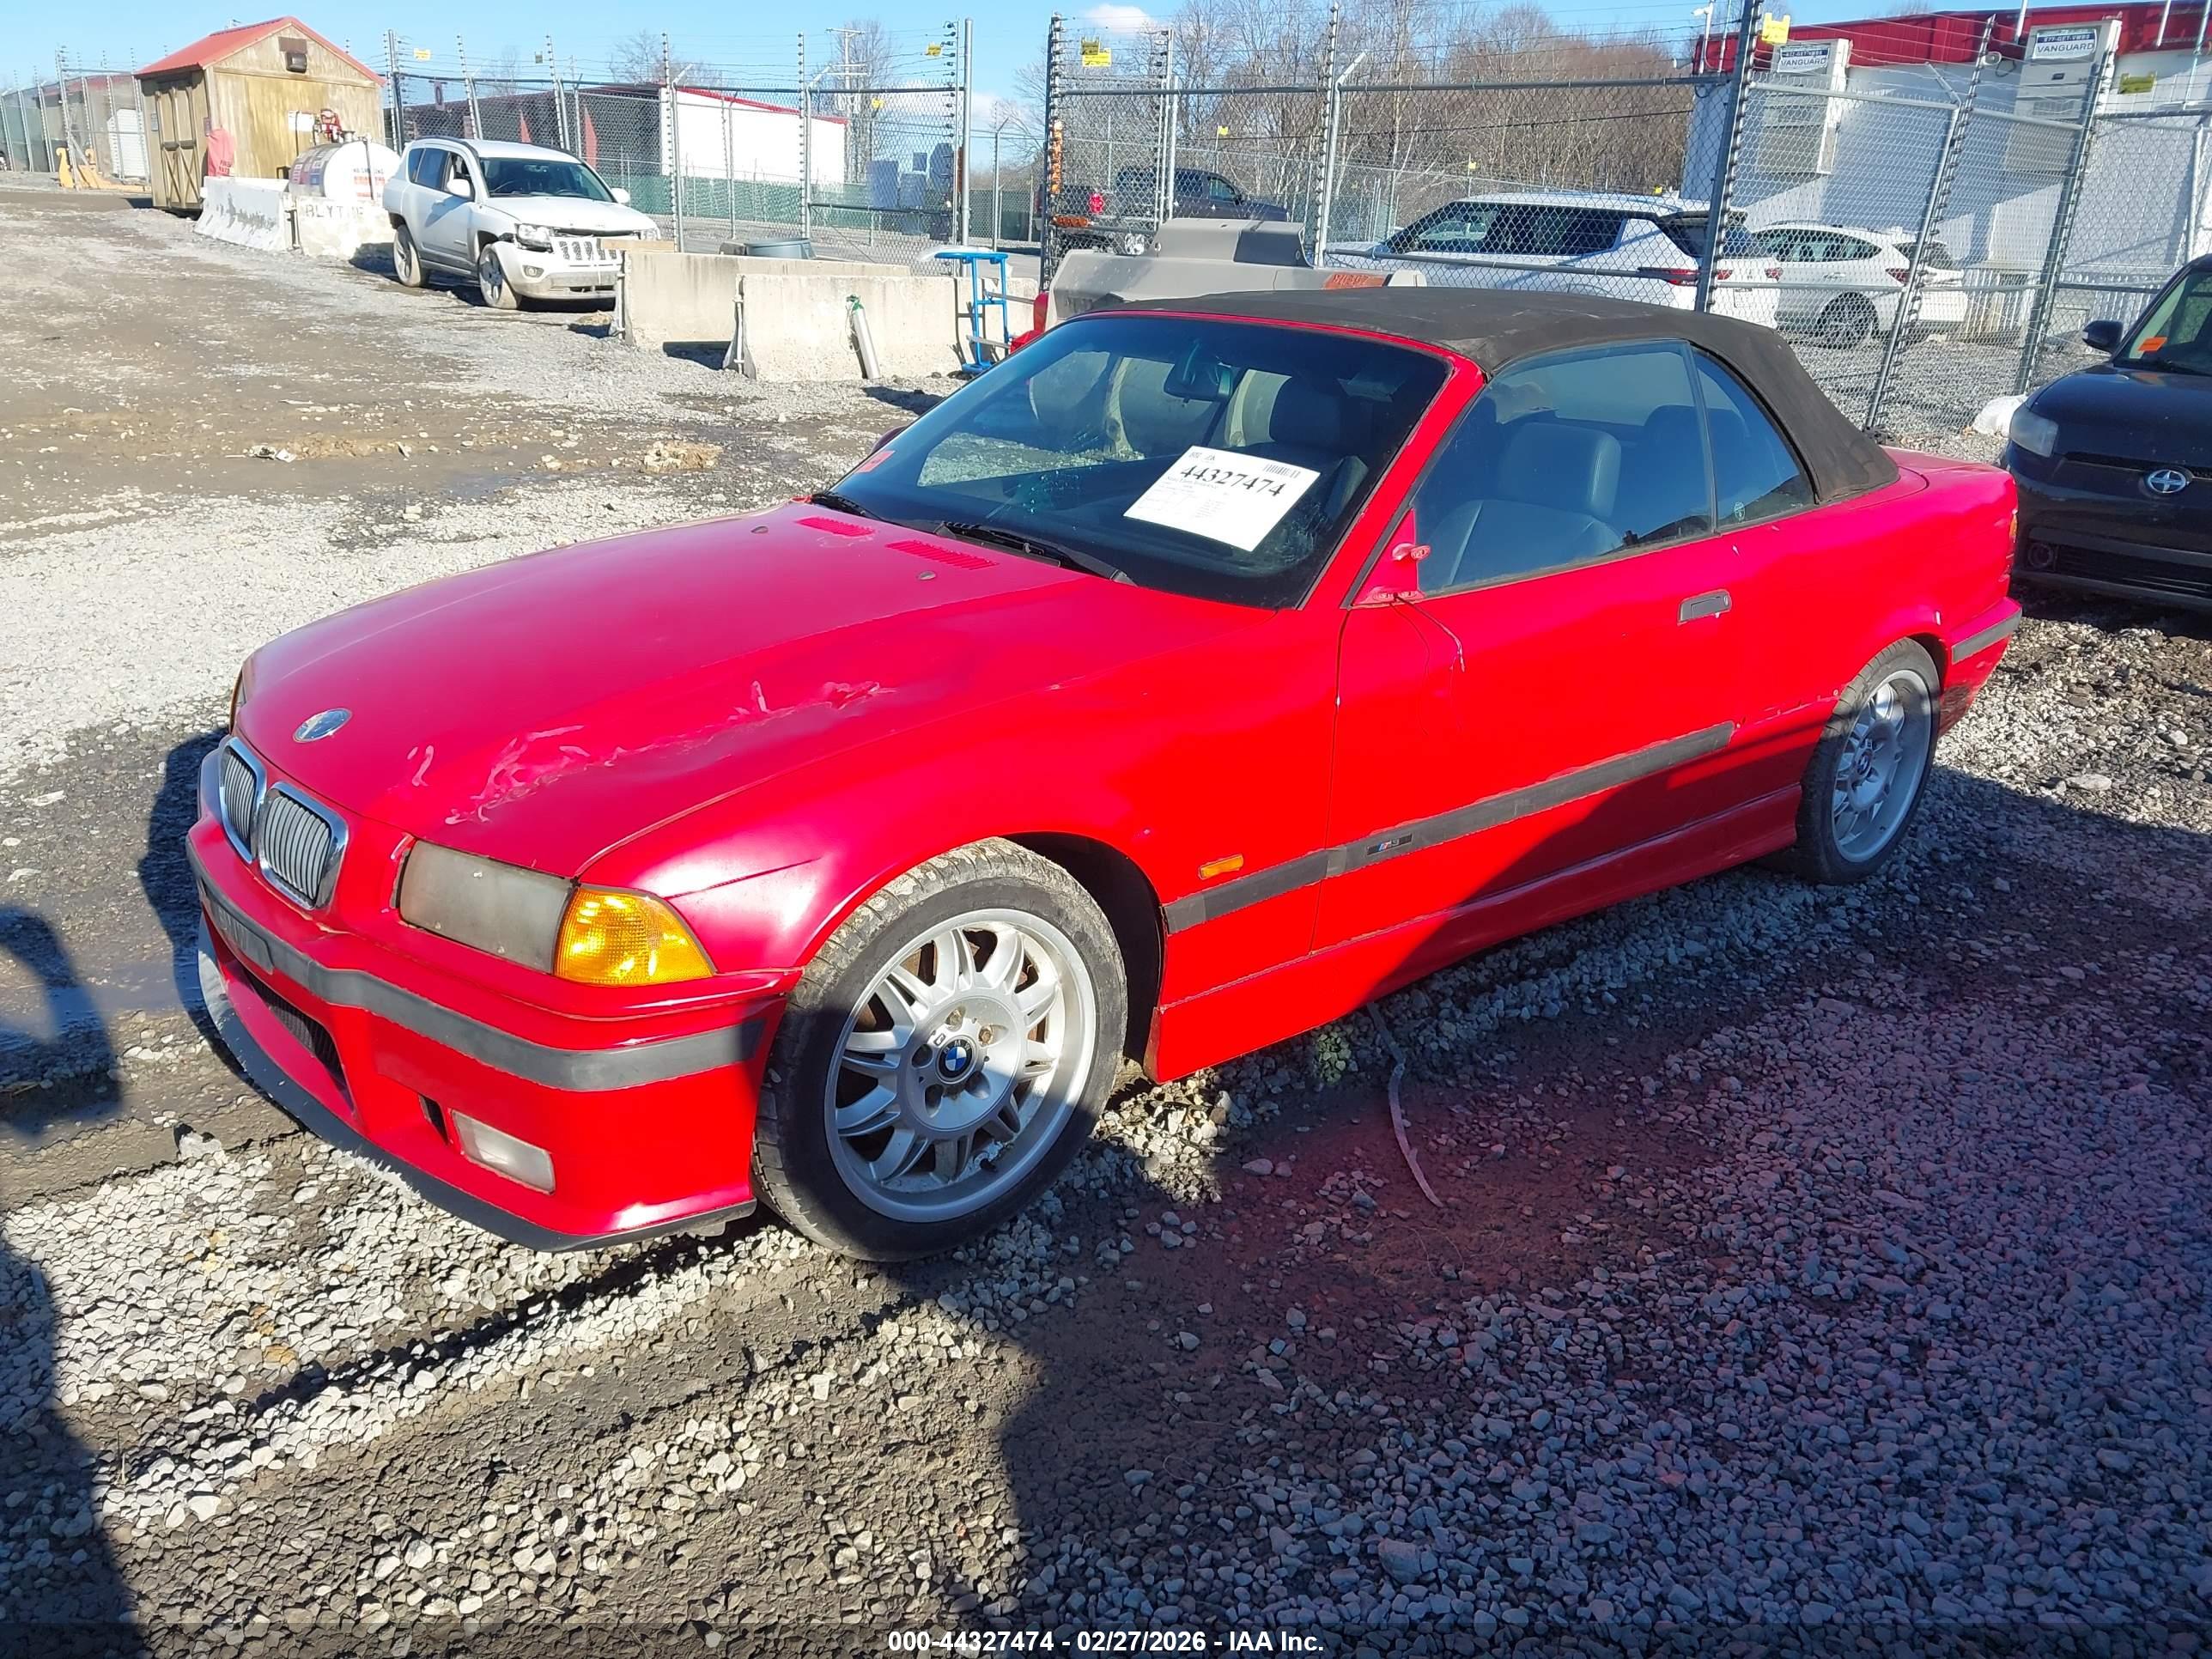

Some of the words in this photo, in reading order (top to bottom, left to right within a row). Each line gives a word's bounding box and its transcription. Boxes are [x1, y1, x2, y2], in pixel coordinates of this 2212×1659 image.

[2038, 42, 2094, 53] VANGUARD
[1781, 58, 1826, 66] VANGUARD
[1180, 465, 1286, 497] 44327474
[943, 1039, 972, 1054] BMW
